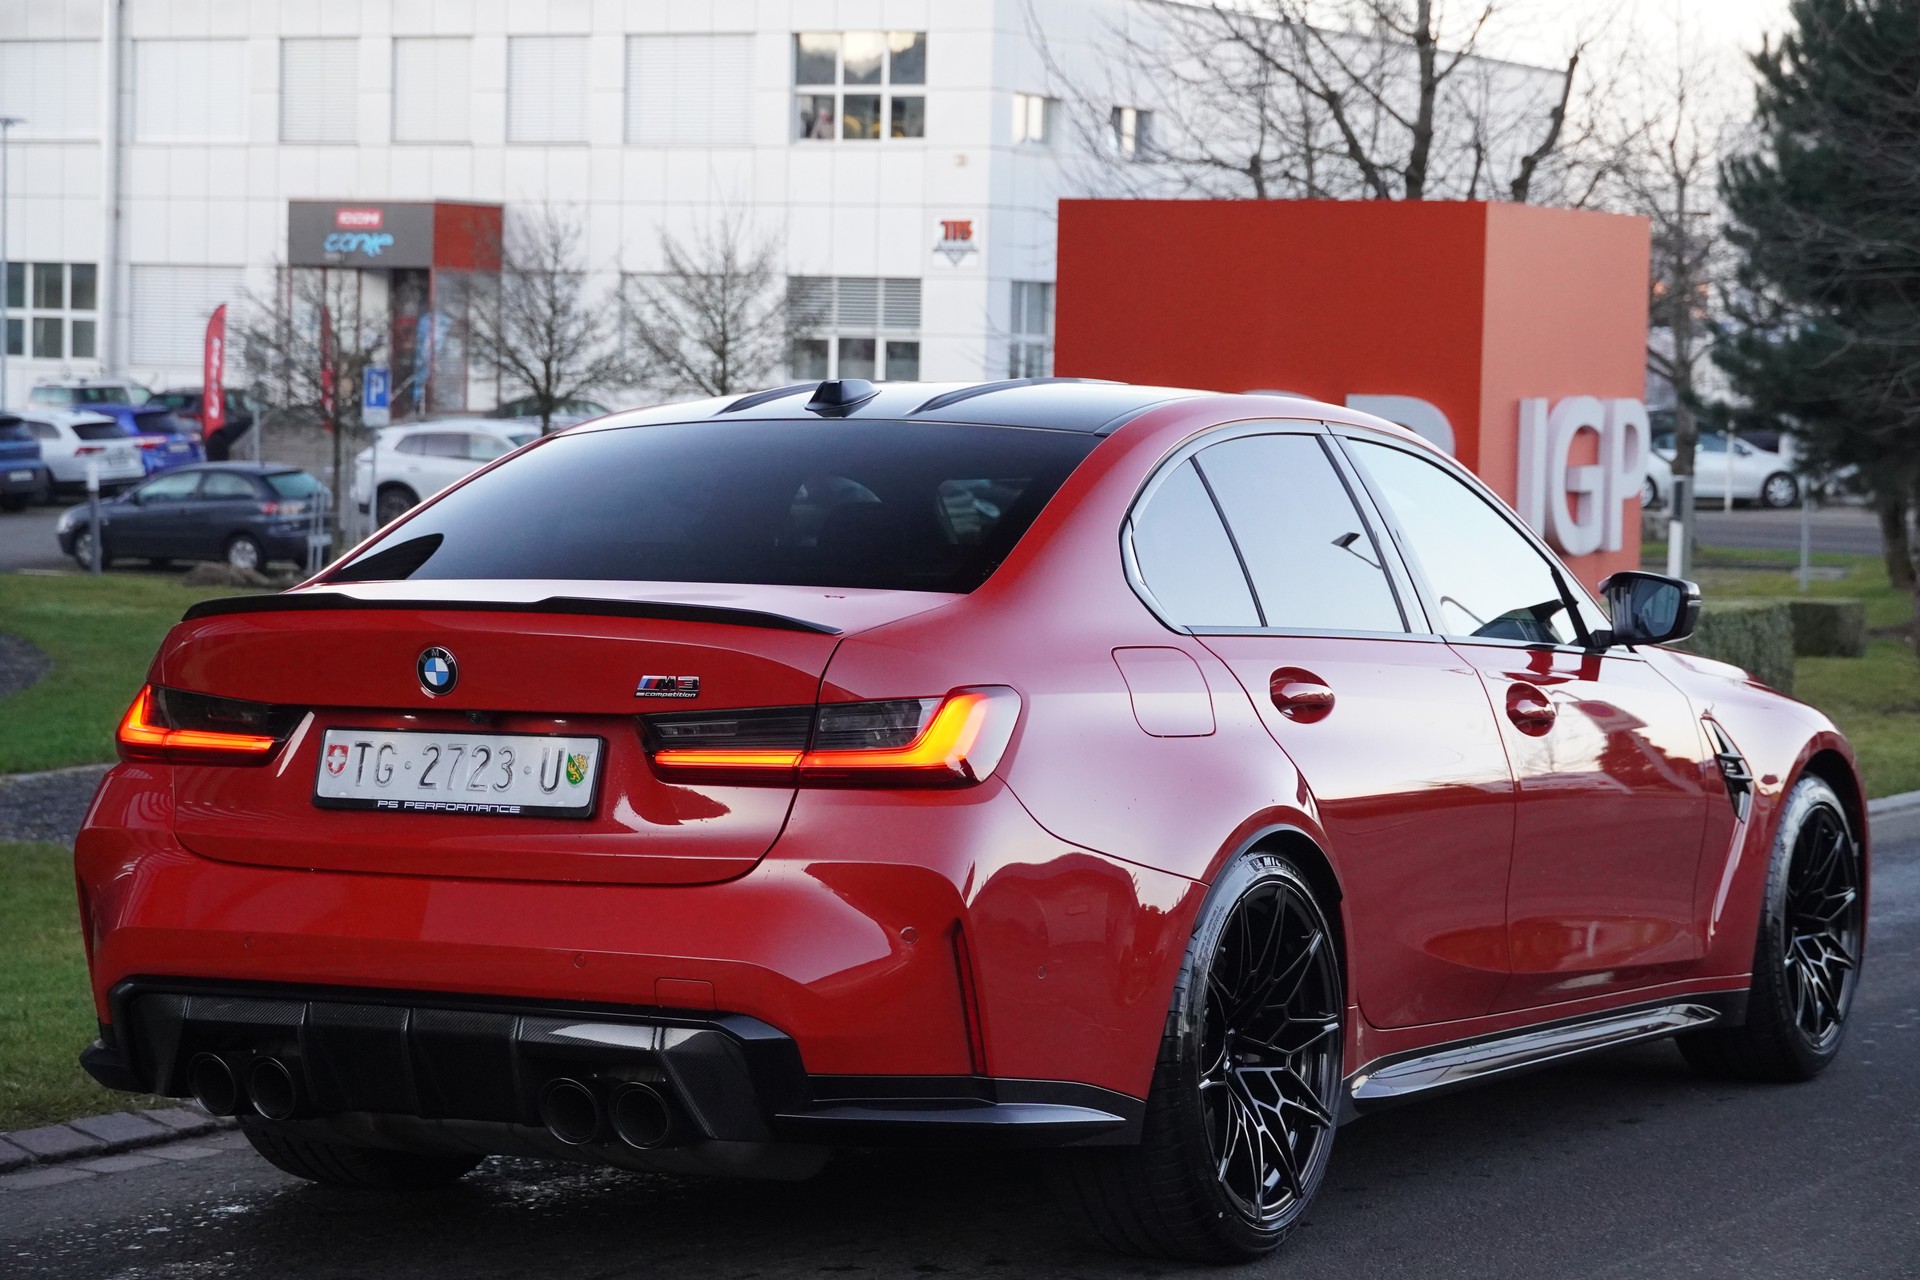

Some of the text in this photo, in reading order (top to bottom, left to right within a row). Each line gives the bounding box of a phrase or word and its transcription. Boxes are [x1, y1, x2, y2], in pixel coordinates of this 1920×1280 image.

[369, 373, 385, 404] P
[1517, 395, 1651, 556] IGP
[420, 649, 453, 665] BMW
[646, 675, 700, 691] M3
[354, 740, 566, 794] TG 2723 U
[377, 800, 521, 814] PS PERFORMANCE
